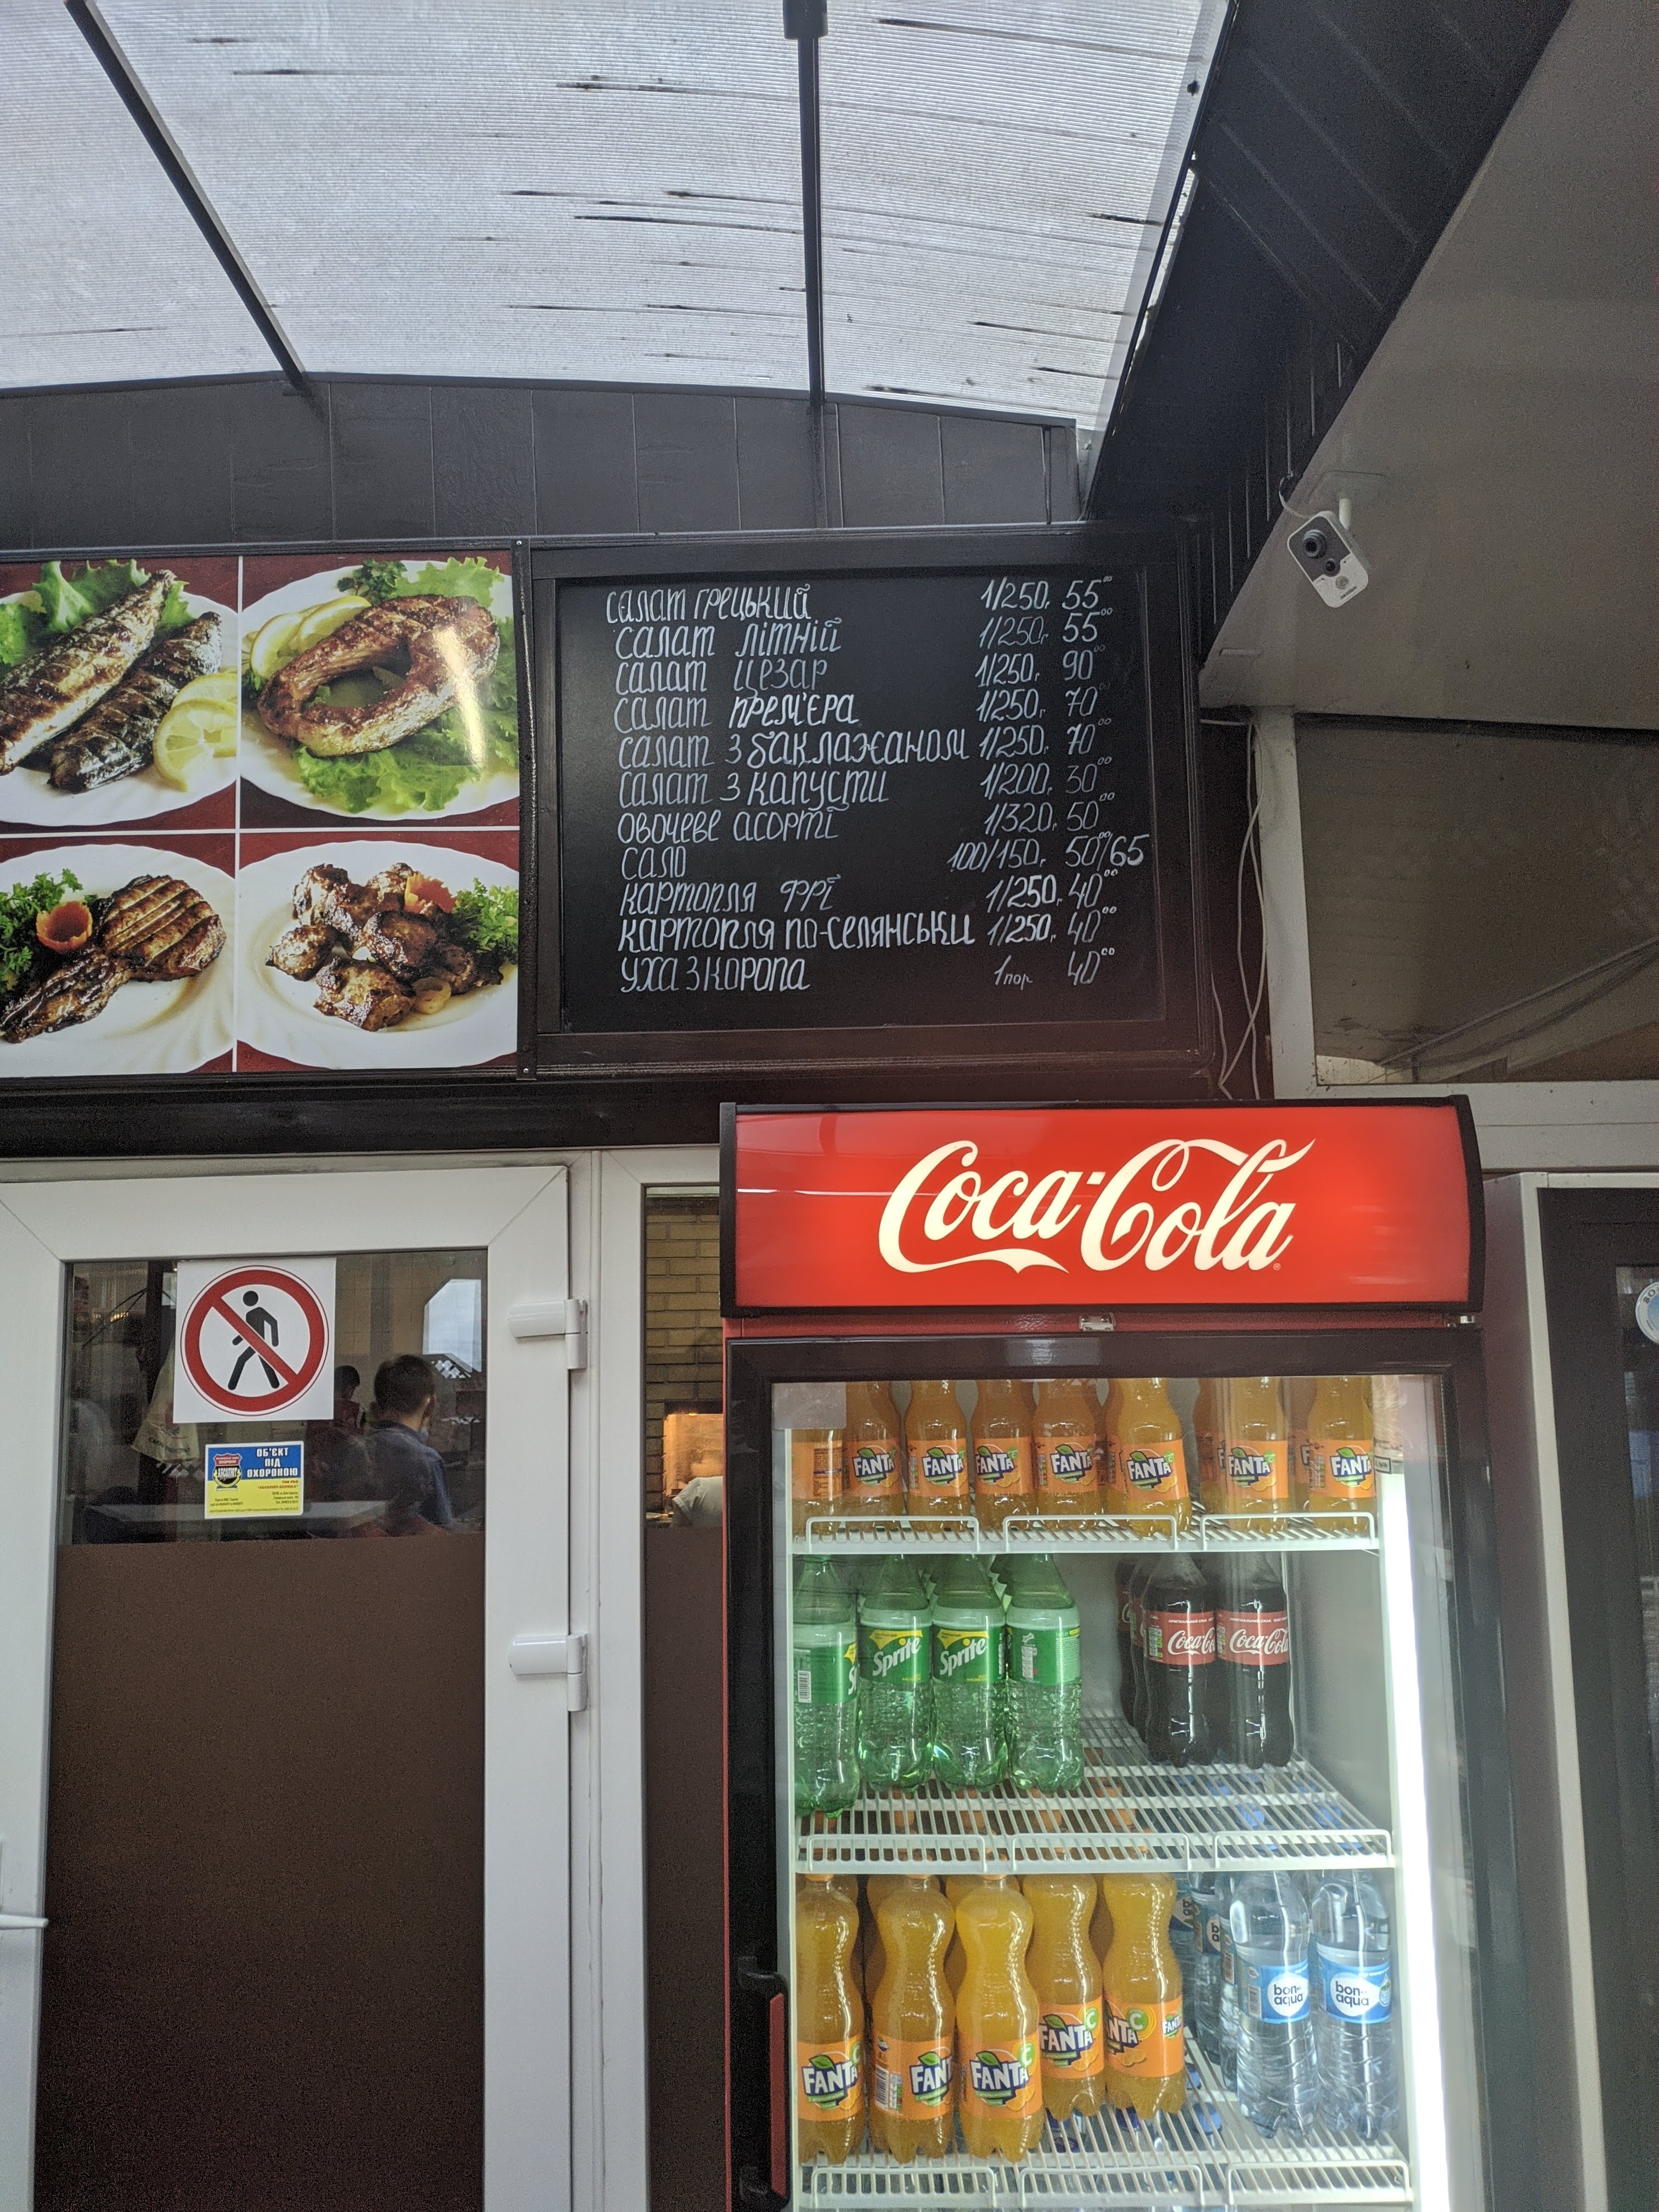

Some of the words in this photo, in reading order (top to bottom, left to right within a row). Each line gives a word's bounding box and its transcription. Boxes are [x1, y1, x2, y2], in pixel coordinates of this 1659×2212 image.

[878, 1138, 1316, 1274] Coca-Cola
[256, 1448, 289, 1457] ОБ'ЄКТ
[264, 1458, 280, 1468] ПІД
[1051, 1452, 1092, 1473] FANTA
[247, 1468, 298, 1478] ОХОРОНОЮ
[853, 1454, 894, 1476] FANTA
[923, 1454, 963, 1476] FANTA
[975, 1454, 1014, 1474] FANTA
[1127, 1457, 1171, 1480] FANTA
[1228, 1456, 1271, 1476] FANTA
[1330, 1455, 1372, 1476] FANTA
[872, 1637, 921, 1677] Sprite
[940, 1638, 987, 1677] Sprite
[1274, 1994, 1303, 2006] aqua
[1336, 1994, 1369, 2008] aqua
[1039, 2024, 1093, 2052] FANTA
[1108, 2017, 1139, 2044] NTA
[803, 2062, 858, 2095] FANTA
[970, 2061, 1029, 2091] FANTA
